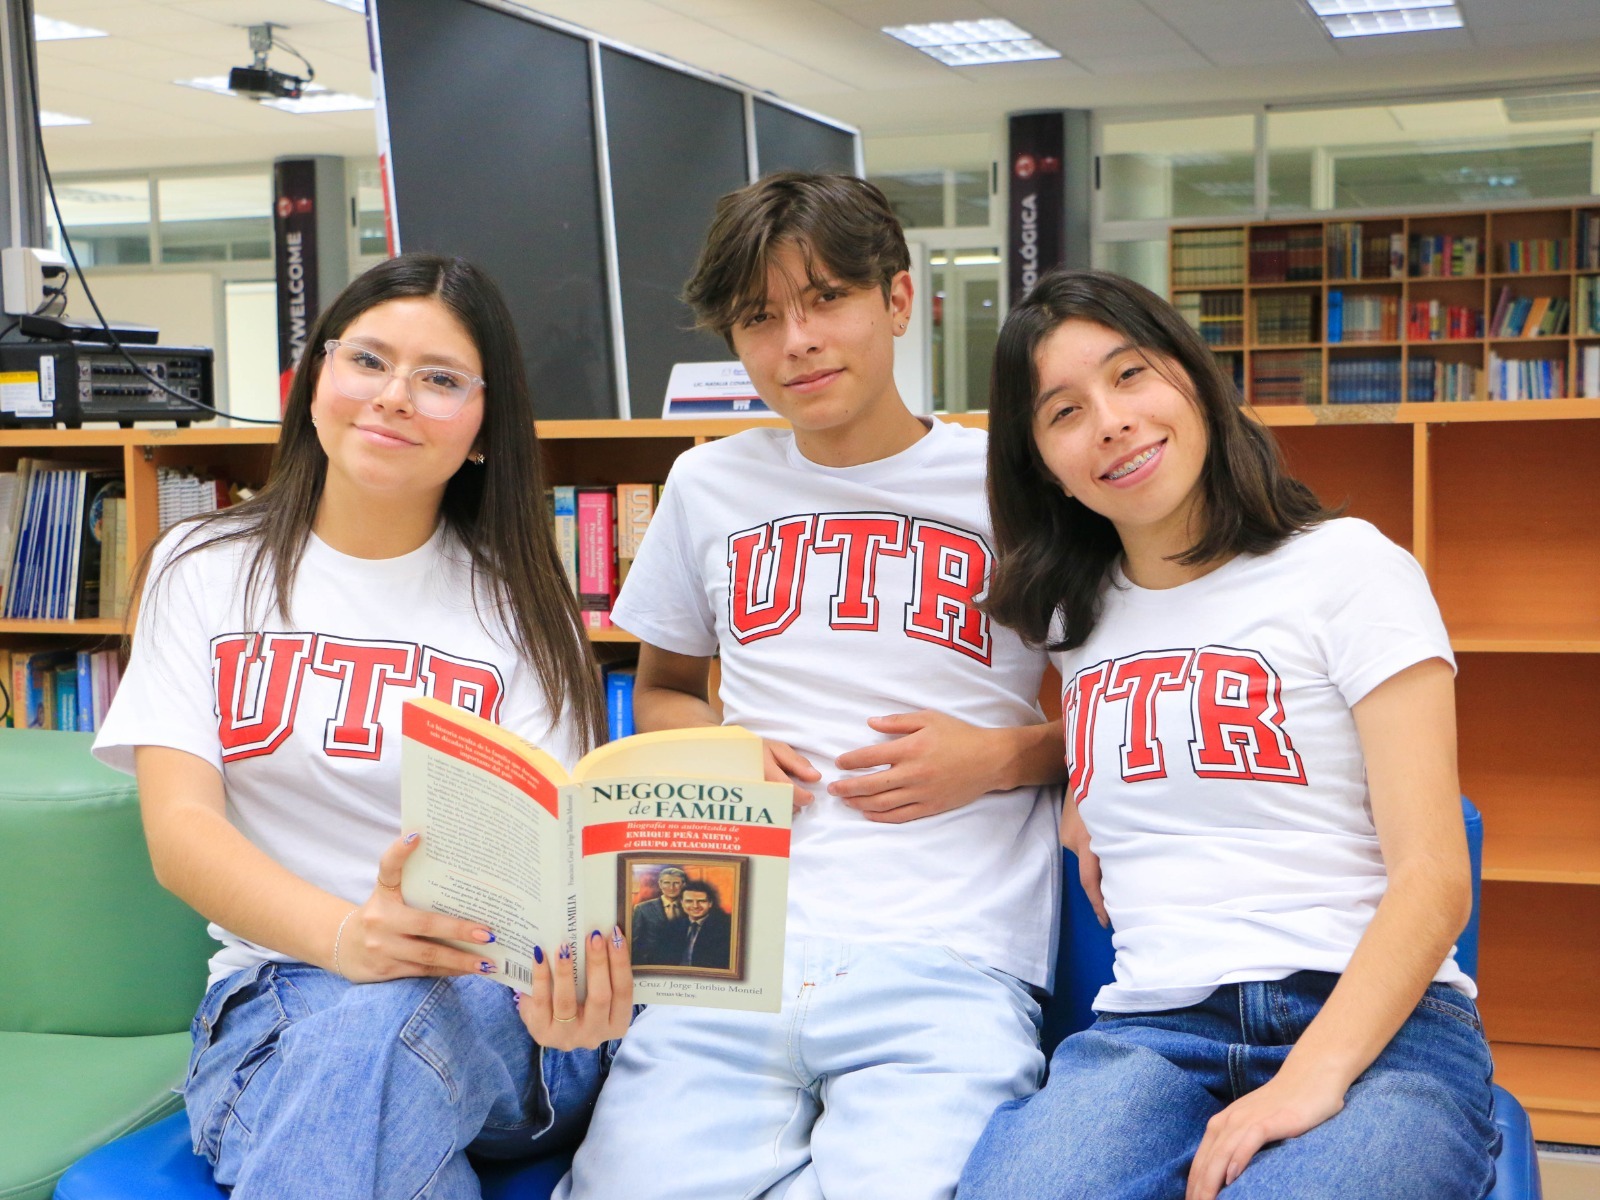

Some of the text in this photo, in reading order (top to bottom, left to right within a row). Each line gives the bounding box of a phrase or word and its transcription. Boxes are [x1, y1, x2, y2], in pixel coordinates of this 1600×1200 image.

[727, 511, 997, 667] UTR
[592, 783, 744, 803] NEGOCIOS
[629, 801, 775, 824] de FAMILIA
[626, 822, 666, 831] Biografía
[681, 823, 727, 832] autorizada
[626, 831, 671, 839] ENRIQUE
[673, 831, 700, 840] PEÑA
[702, 833, 732, 841] NIETO
[633, 840, 669, 848] GRUPO
[670, 840, 741, 851] ATLACOMULCO
[567, 894, 577, 932] FAMILIA
[639, 980, 661, 988] Cruz
[669, 980, 692, 990] Jorge
[694, 982, 725, 992] Toribio
[728, 985, 763, 995] Montiel
